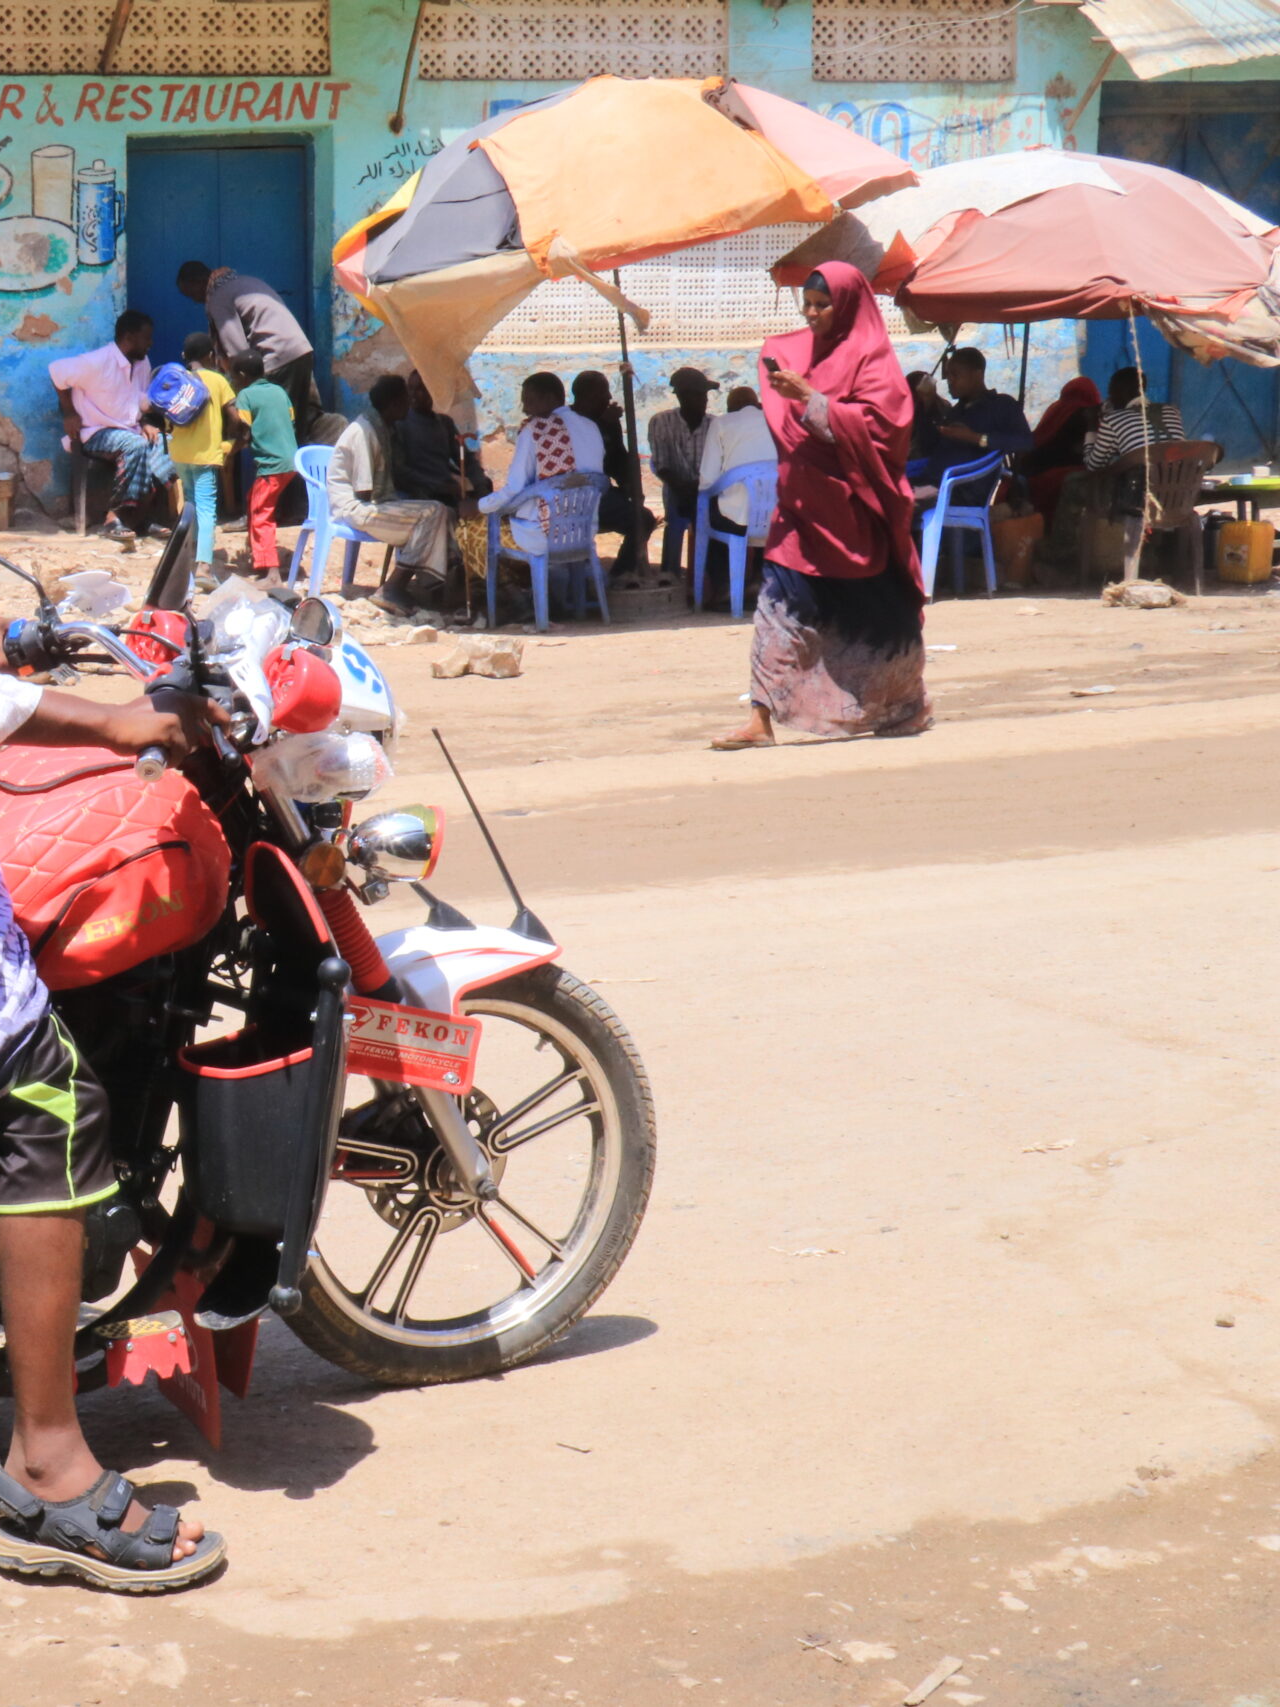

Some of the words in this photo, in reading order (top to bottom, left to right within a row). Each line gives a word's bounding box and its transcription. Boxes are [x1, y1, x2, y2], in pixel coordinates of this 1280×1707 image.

[35, 83, 65, 126] &
[73, 81, 352, 123] RESTAURANT
[376, 1014, 470, 1046] FEKON
[364, 1046, 396, 1057] FEKON
[398, 1051, 462, 1068] MOTORCYCLE
